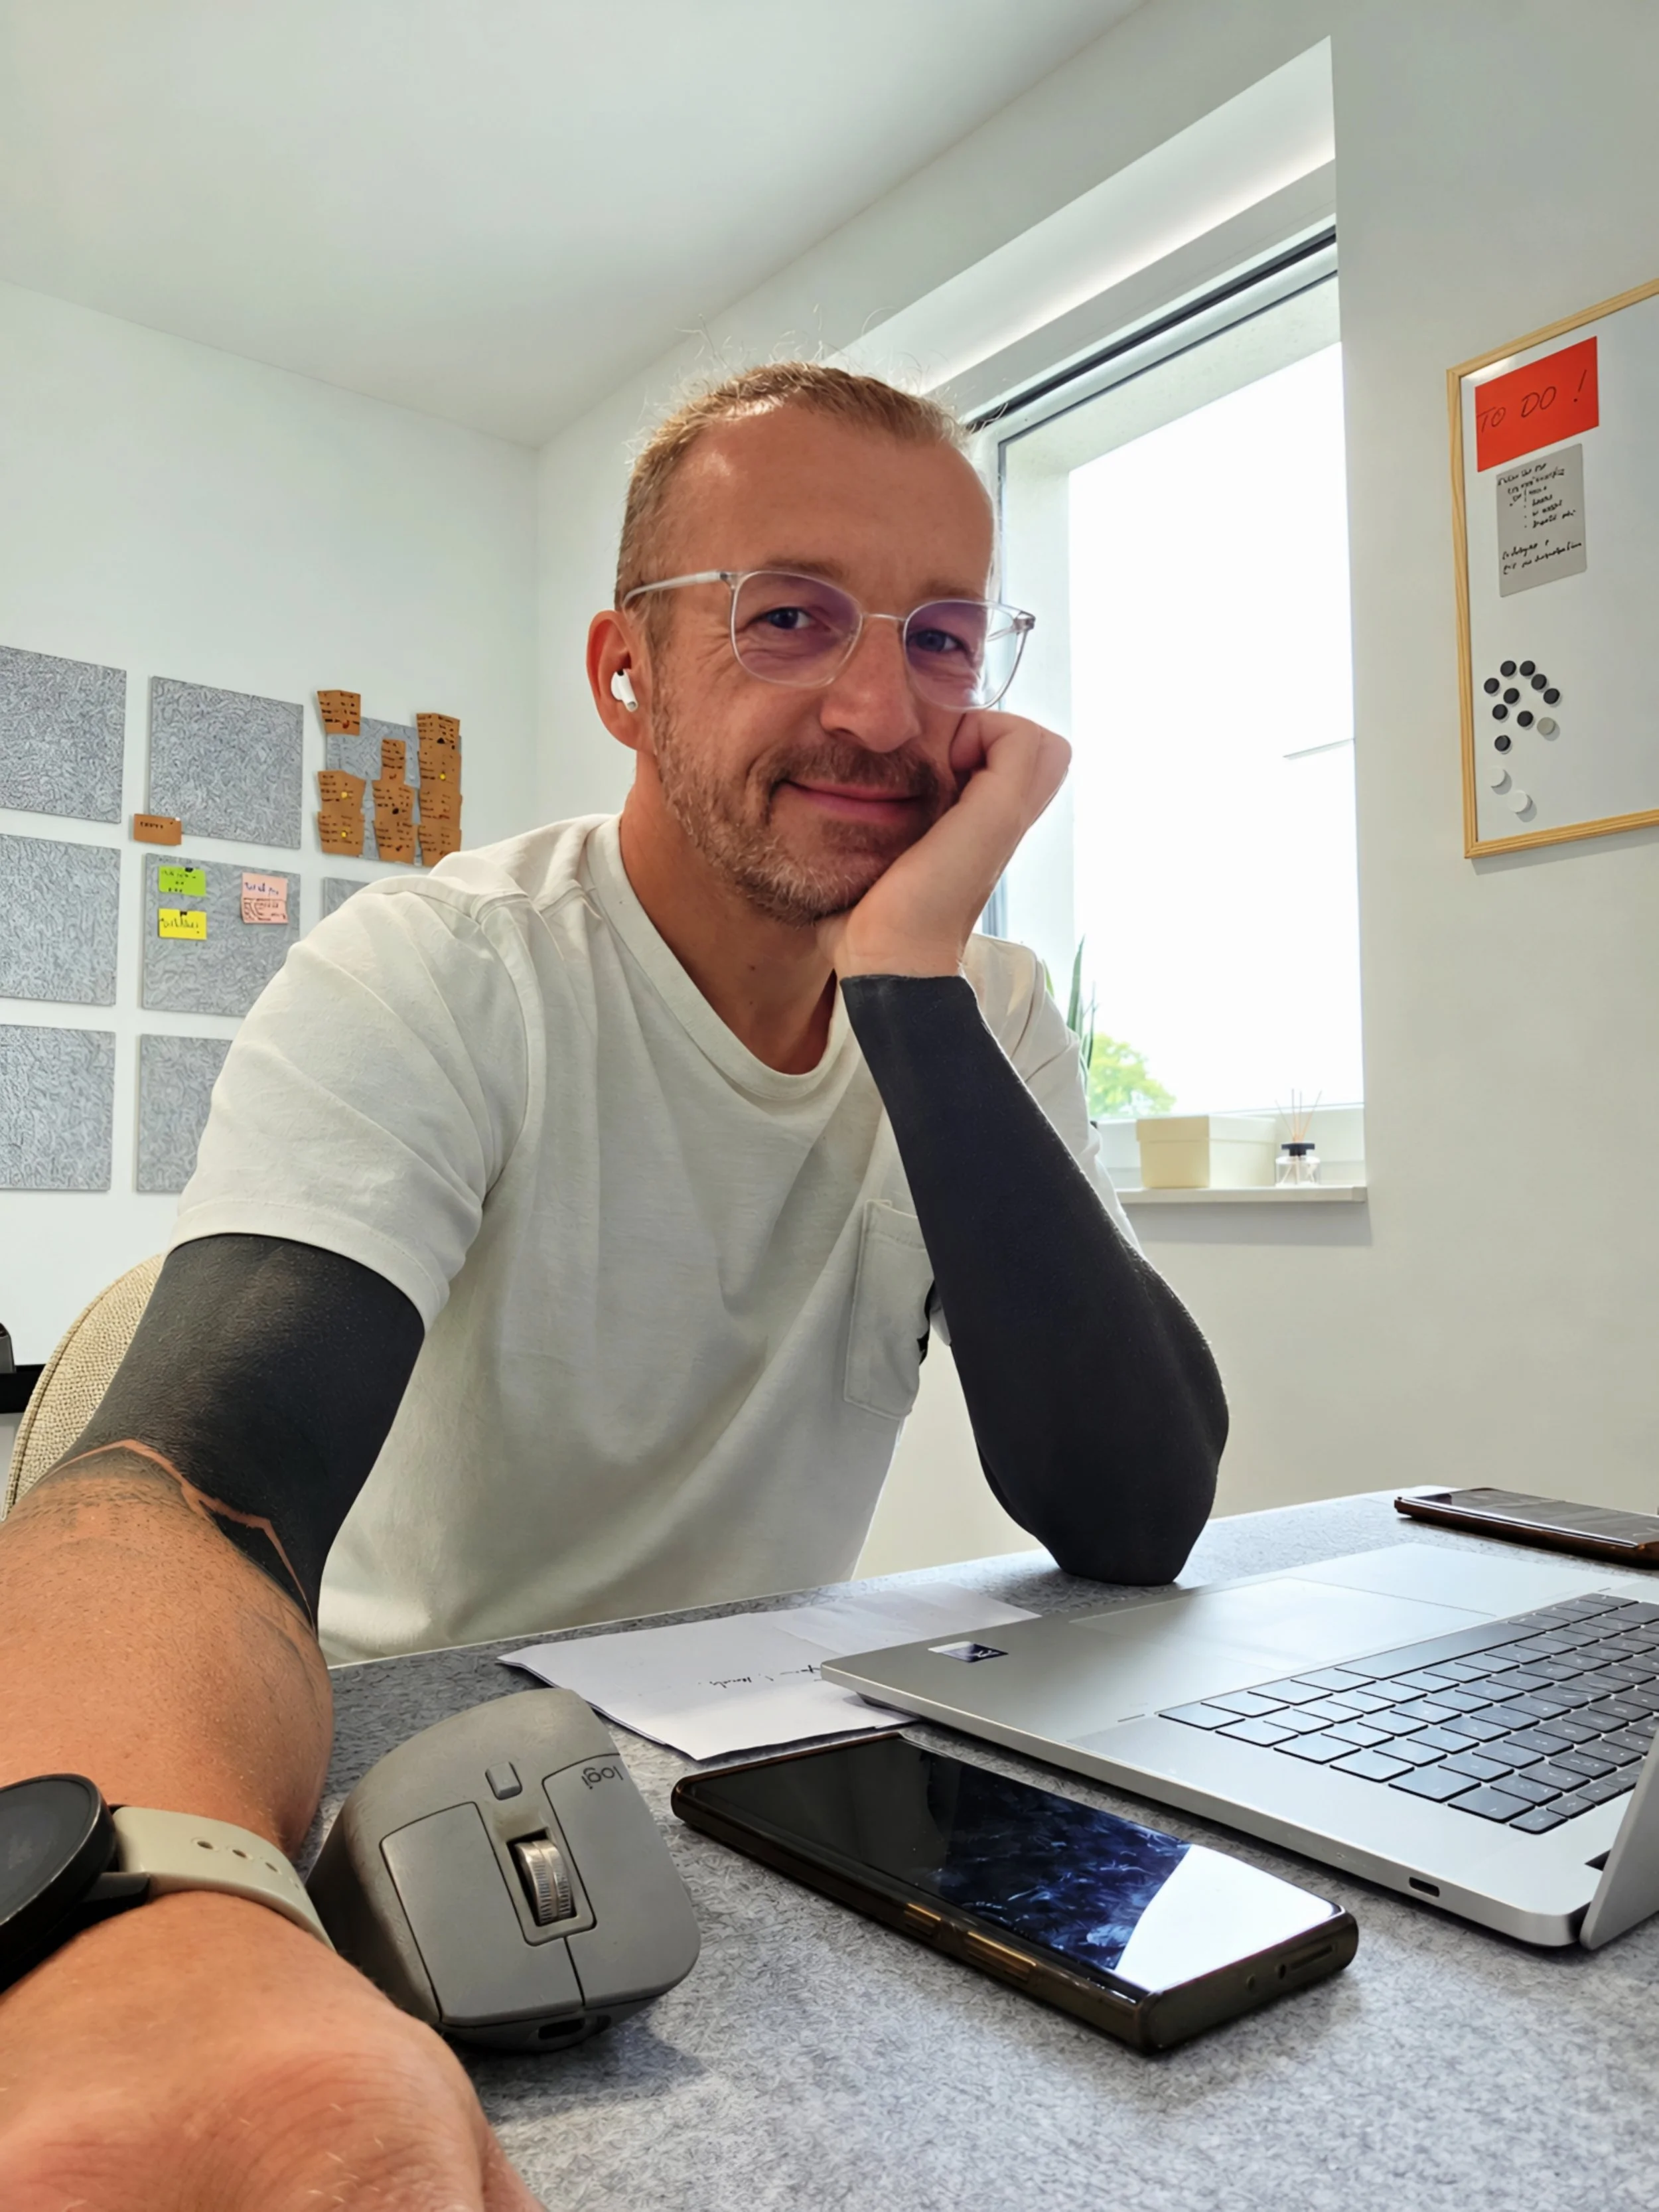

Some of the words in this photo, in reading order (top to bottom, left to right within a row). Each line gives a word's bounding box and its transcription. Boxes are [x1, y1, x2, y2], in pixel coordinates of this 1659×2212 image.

[1477, 406, 1506, 433] TO
[1520, 386, 1557, 418] DO
[581, 1765, 624, 1790] logi
